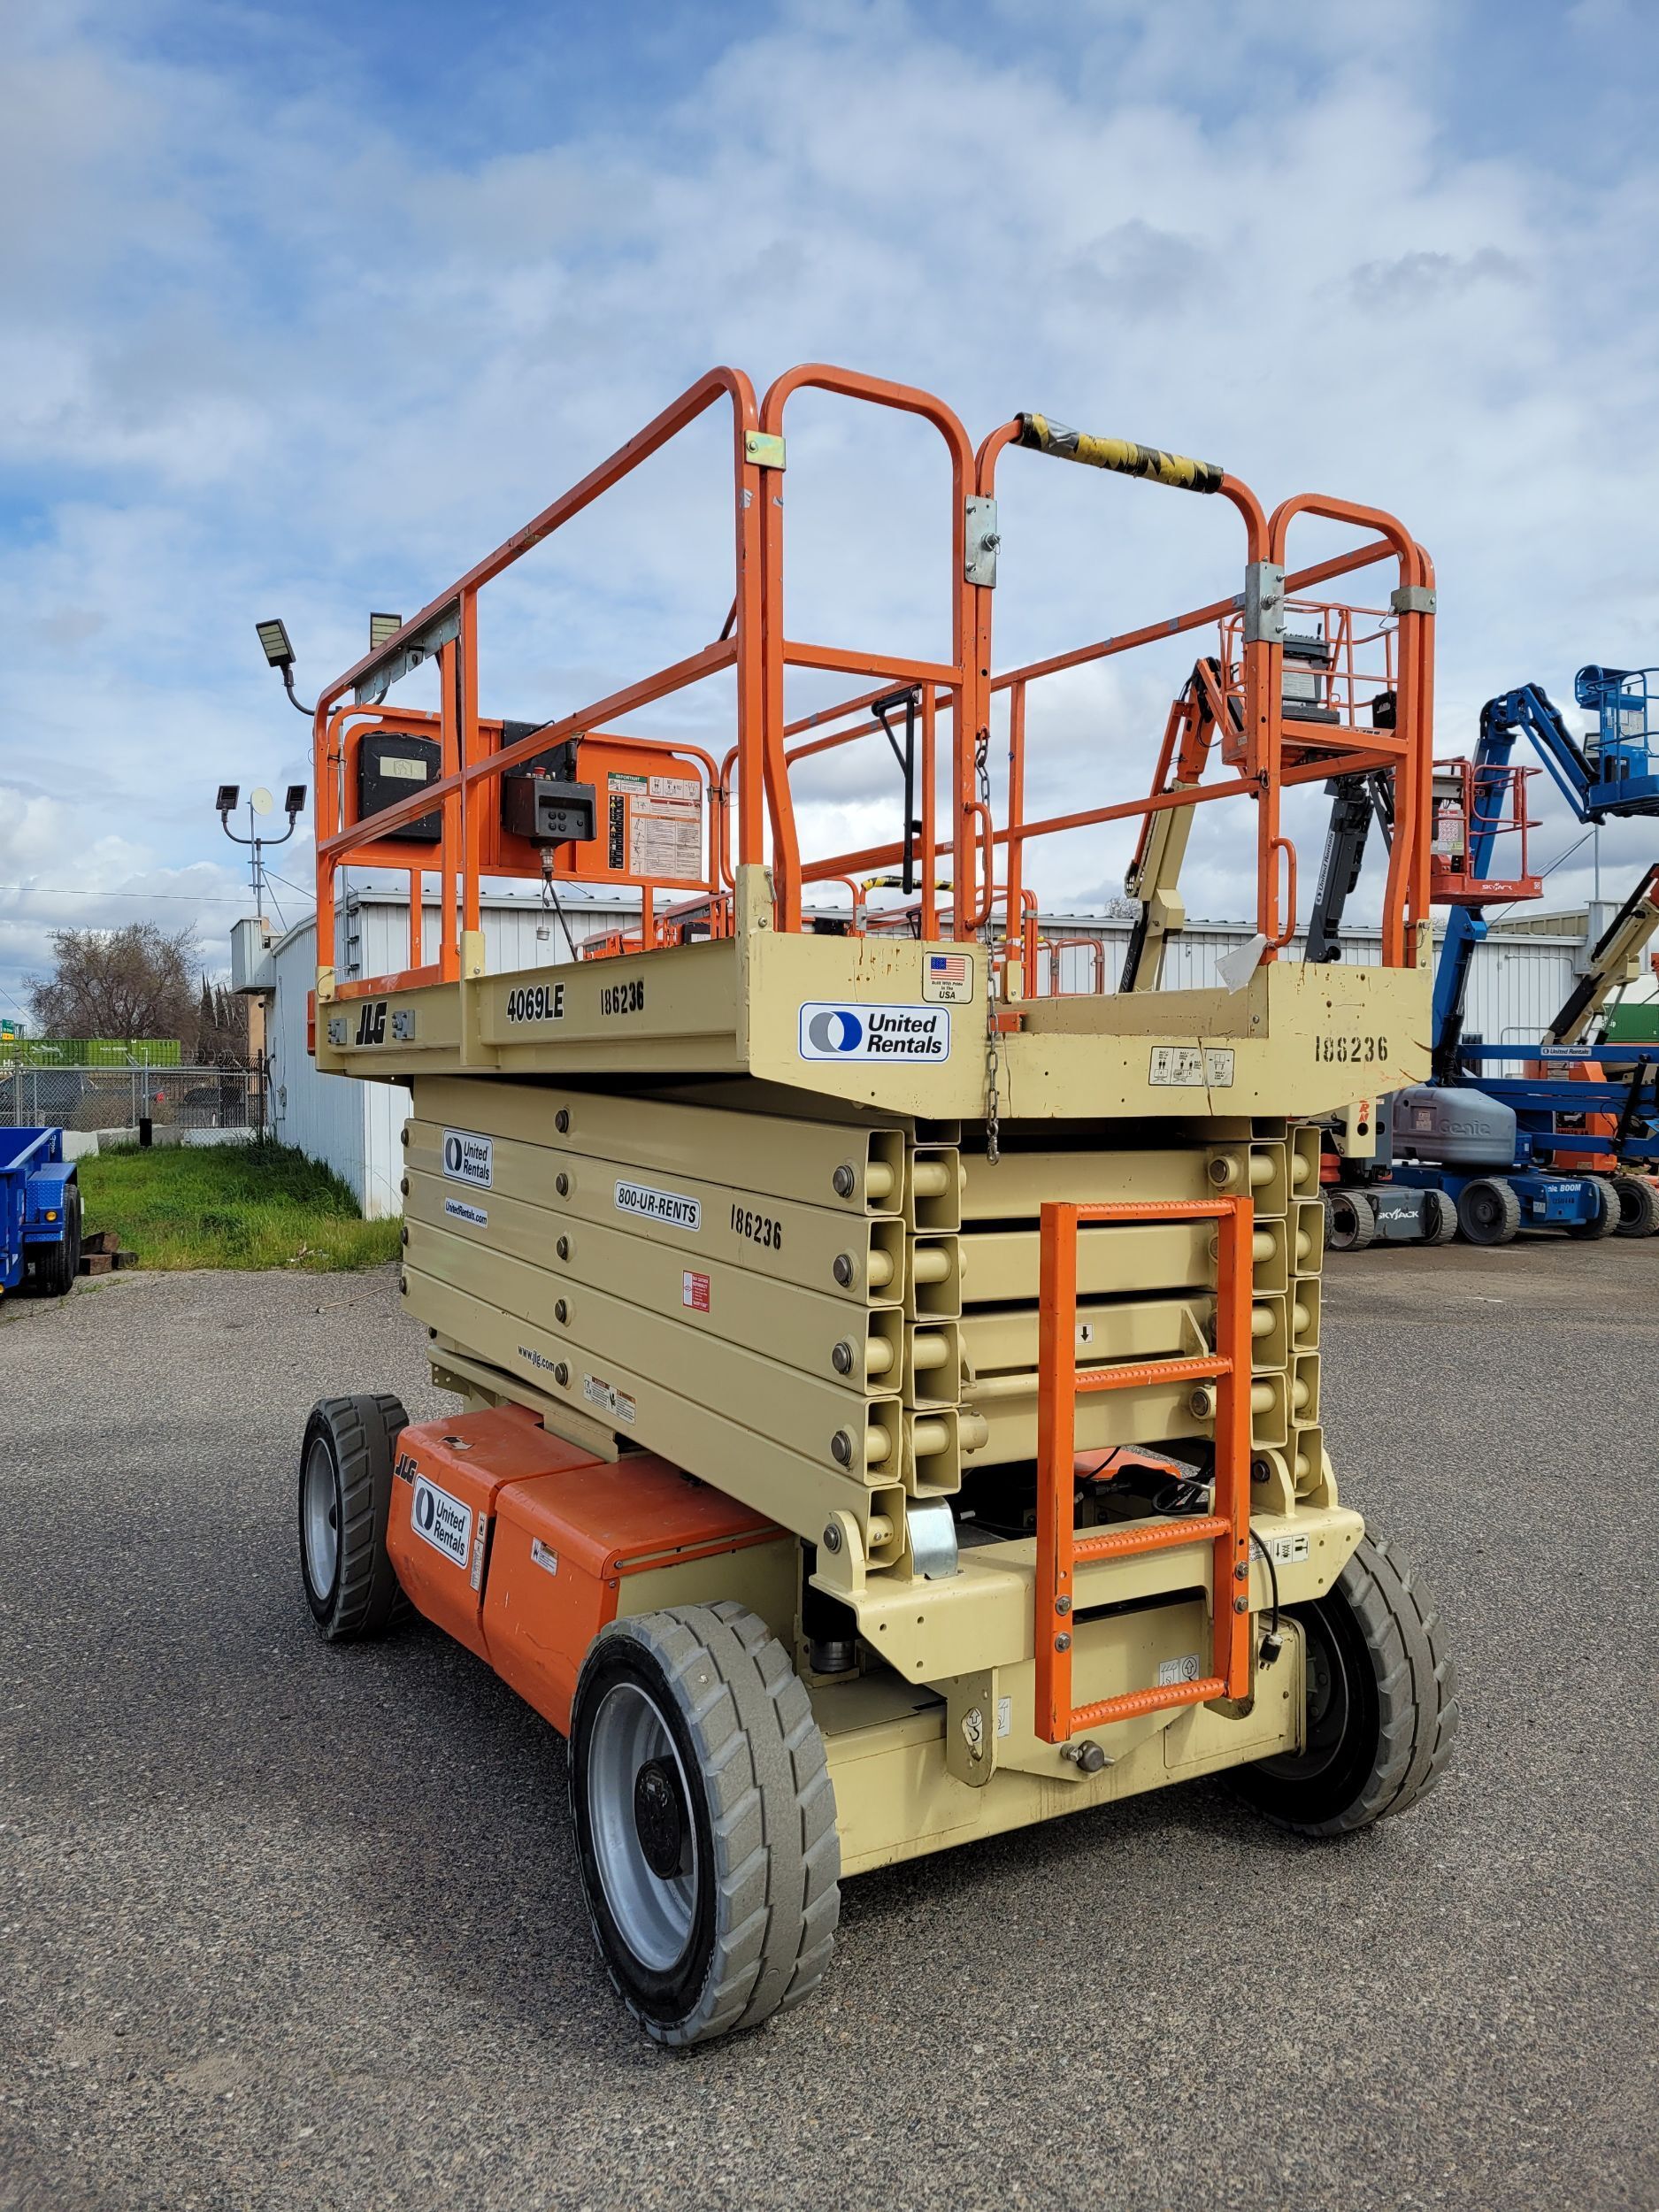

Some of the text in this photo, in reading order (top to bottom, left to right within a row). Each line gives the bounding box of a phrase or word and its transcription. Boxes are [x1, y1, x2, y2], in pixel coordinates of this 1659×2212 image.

[1318, 833, 1333, 891] United Rentals
[507, 984, 565, 1022] 4069LE
[601, 980, 644, 1016] 186236
[356, 1002, 388, 1046] JLG
[868, 1013, 937, 1033] United
[867, 1034, 942, 1053] Rentals
[1316, 1035, 1388, 1062] 186236
[1439, 1119, 1491, 1135] Genie
[464, 1141, 488, 1161] United
[463, 1159, 489, 1180] Rentals
[445, 1201, 487, 1225] UnitedRentals.com
[618, 1187, 696, 1224] 800-UR-RENTS
[1378, 1208, 1419, 1220] SKYJACK
[731, 1203, 781, 1250] 186236
[518, 1345, 555, 1373] www.jlg.com
[395, 1453, 418, 1485] JLG
[437, 1499, 465, 1533] United
[434, 1520, 465, 1556] Rentals
